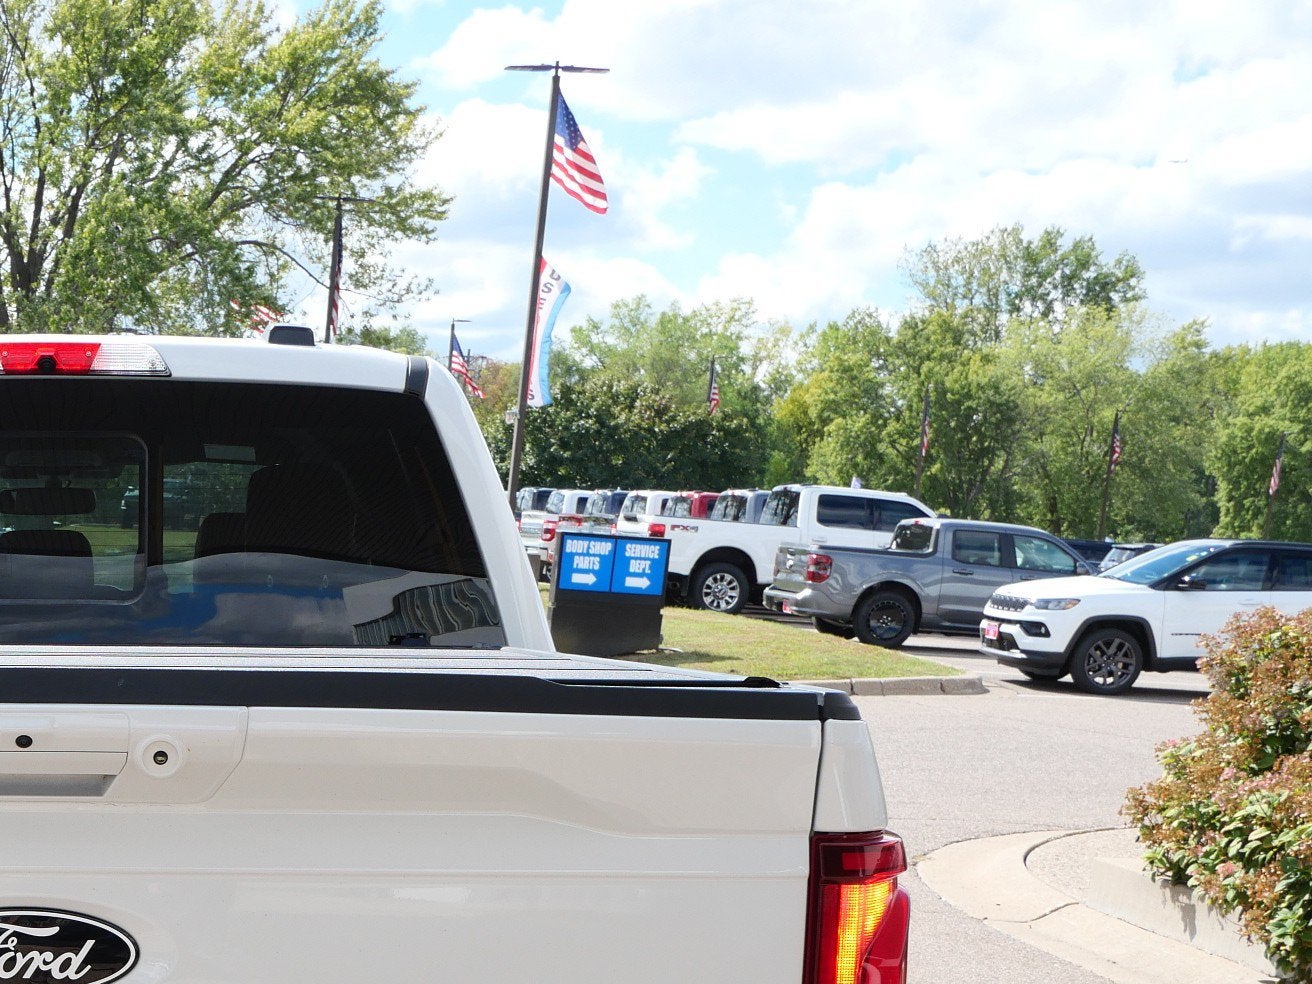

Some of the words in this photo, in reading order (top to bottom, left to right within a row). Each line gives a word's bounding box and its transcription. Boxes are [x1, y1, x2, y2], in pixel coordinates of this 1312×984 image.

[670, 524, 699, 532] FX4
[565, 539, 588, 553] BODY
[589, 542, 612, 555] SHOP
[625, 543, 660, 559] SERVICE
[573, 556, 600, 570] PARTS
[629, 559, 651, 573] DEPT.
